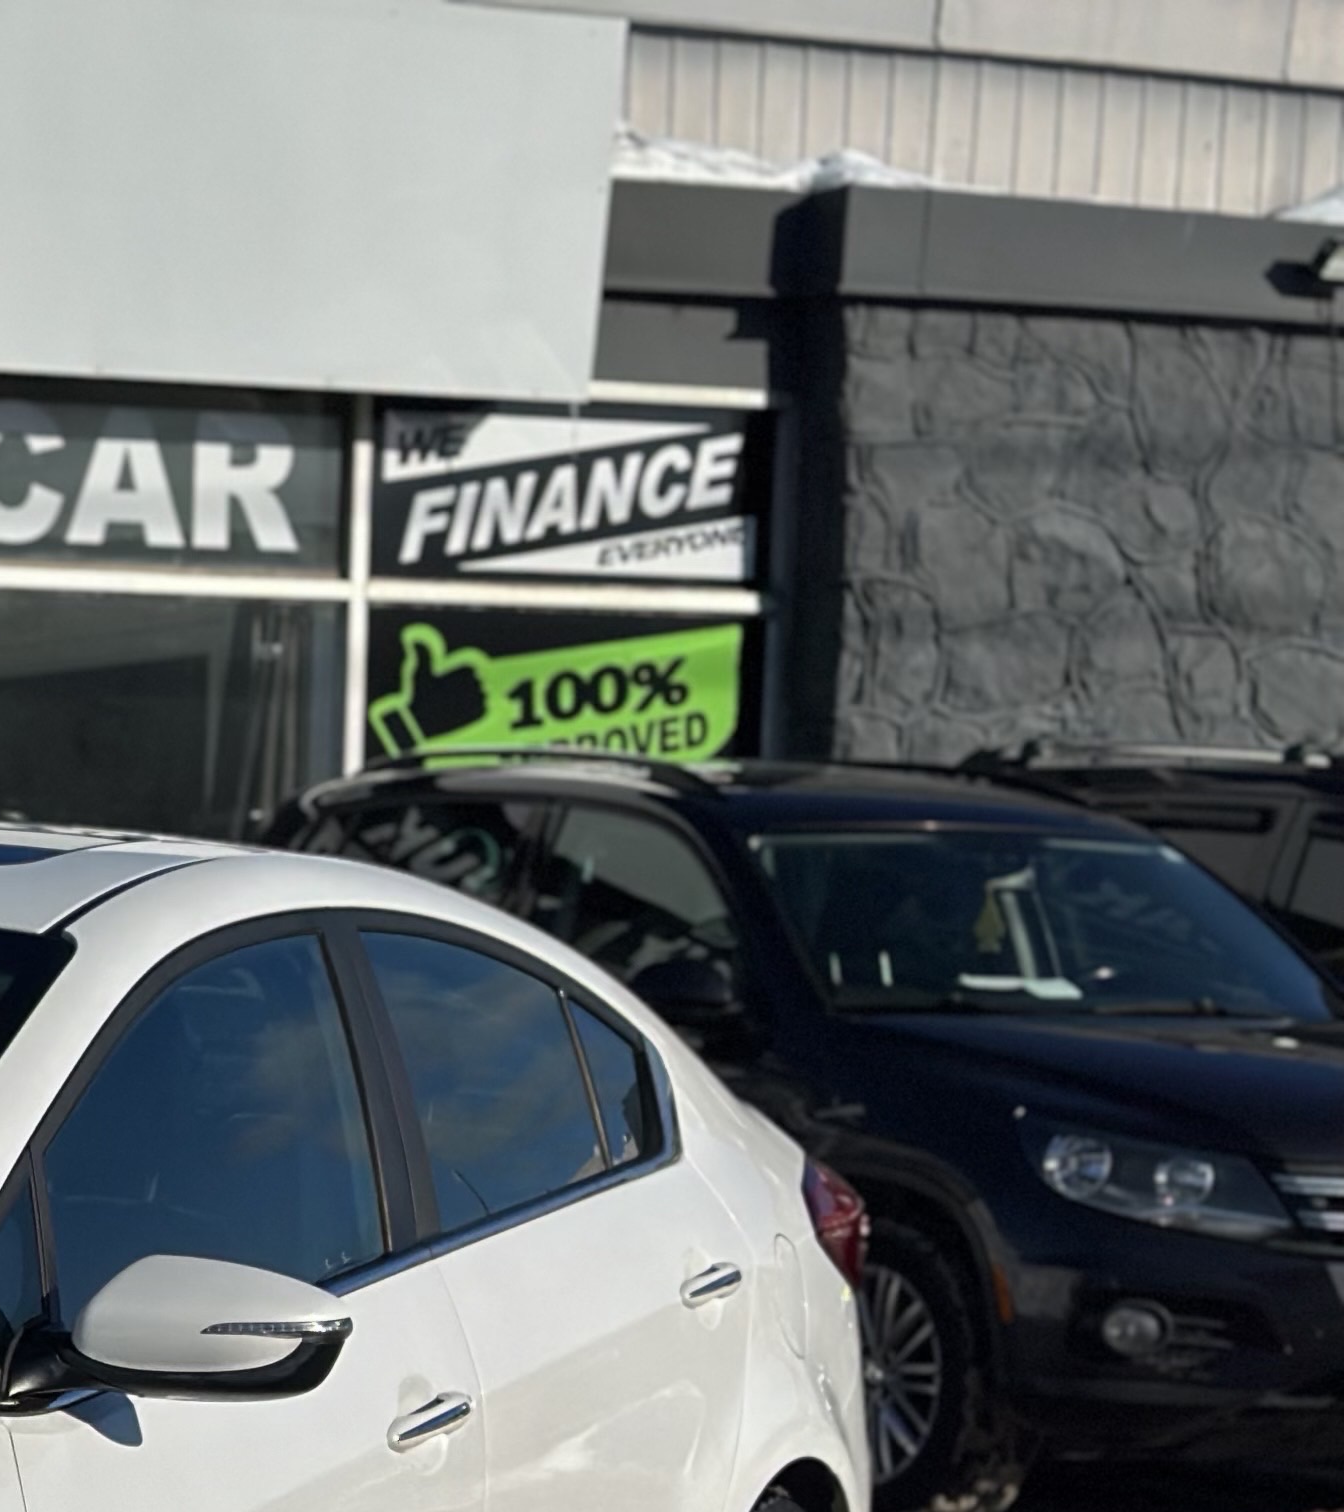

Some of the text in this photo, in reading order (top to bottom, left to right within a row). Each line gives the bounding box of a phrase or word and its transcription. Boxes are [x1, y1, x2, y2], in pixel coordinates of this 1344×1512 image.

[398, 423, 466, 464] WE
[397, 432, 745, 565] FINANCE
[505, 655, 690, 732] 100%
